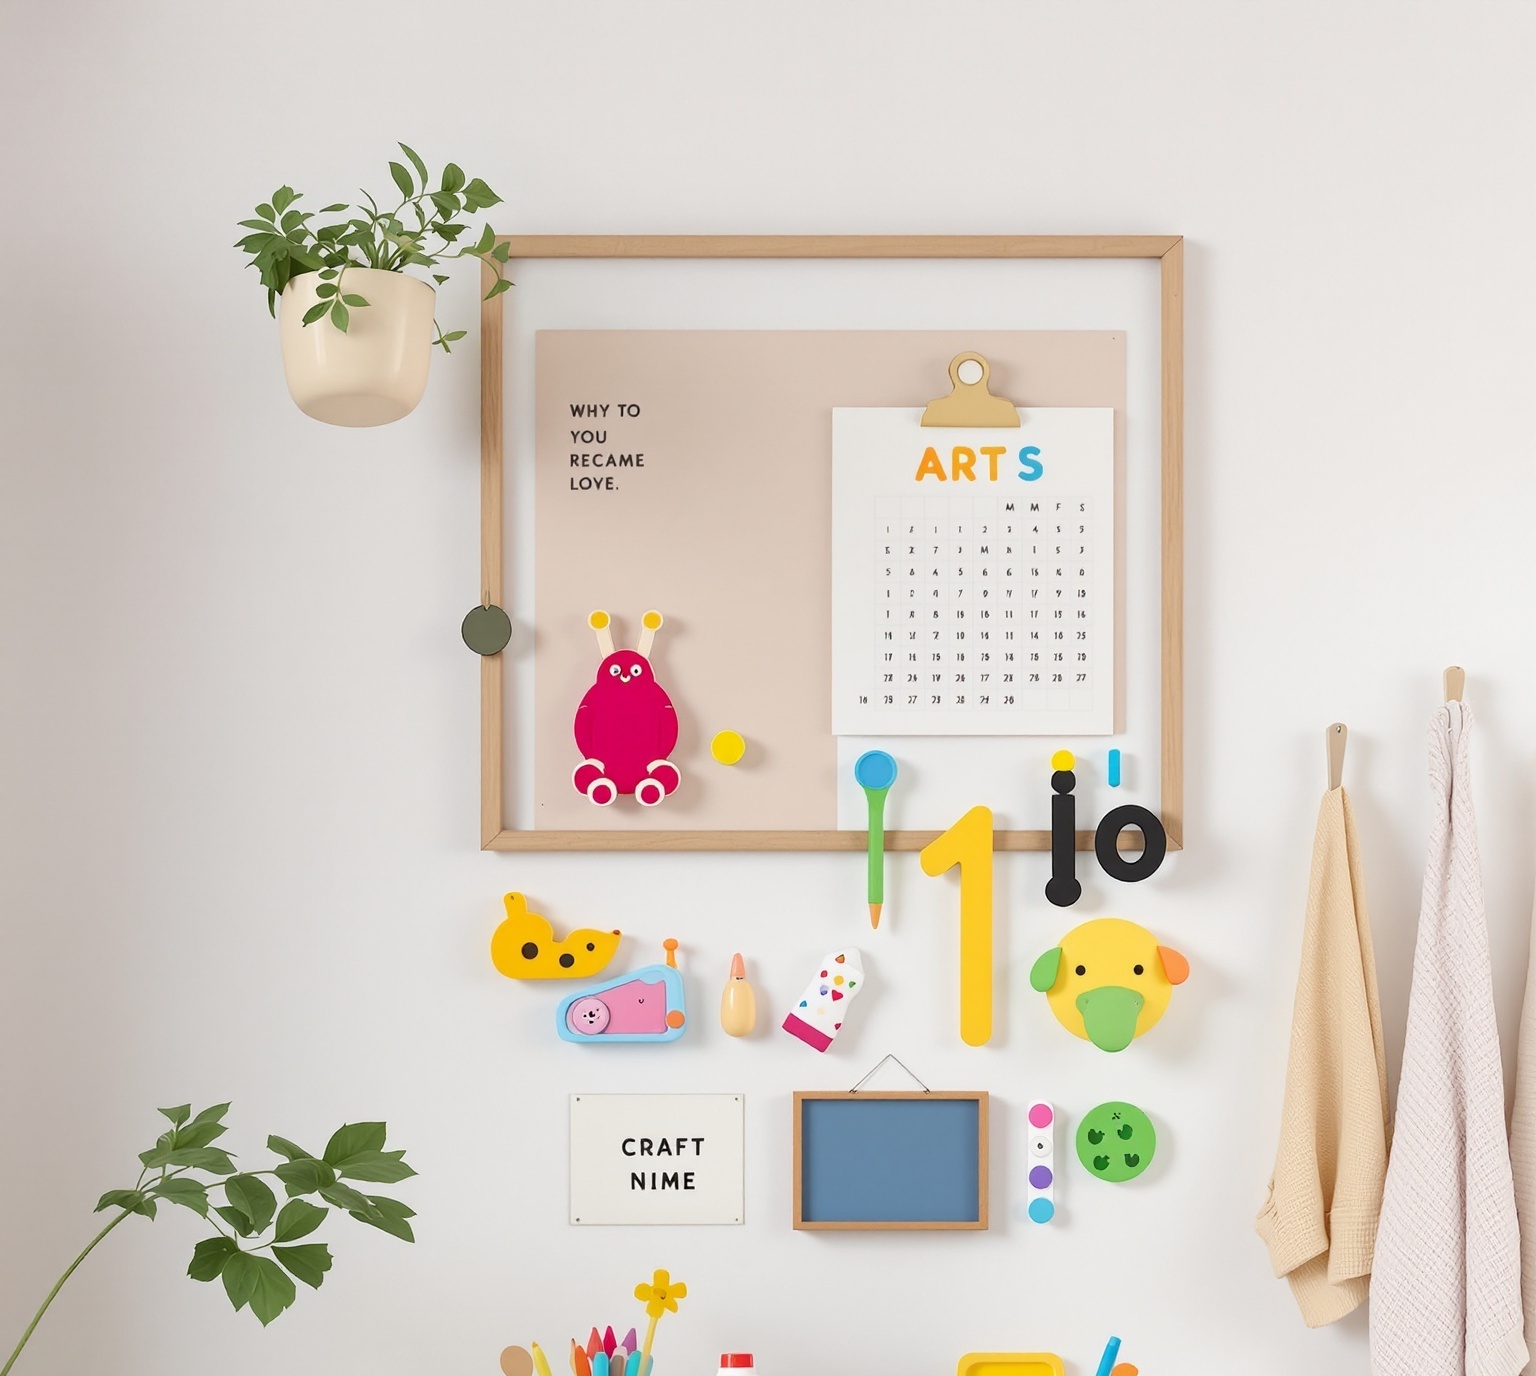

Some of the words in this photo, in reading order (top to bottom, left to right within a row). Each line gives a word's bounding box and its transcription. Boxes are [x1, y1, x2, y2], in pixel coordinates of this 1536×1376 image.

[569, 403, 610, 418] WHY
[617, 403, 641, 418] TO
[570, 430, 607, 444] YOU
[570, 453, 645, 468] RECAME
[1005, 502, 1015, 512] M
[1030, 502, 1040, 512] M
[1055, 502, 1062, 511] F
[1079, 503, 1085, 512] S
[621, 1137, 706, 1157] CRAFT
[631, 1171, 696, 1191] NIME
